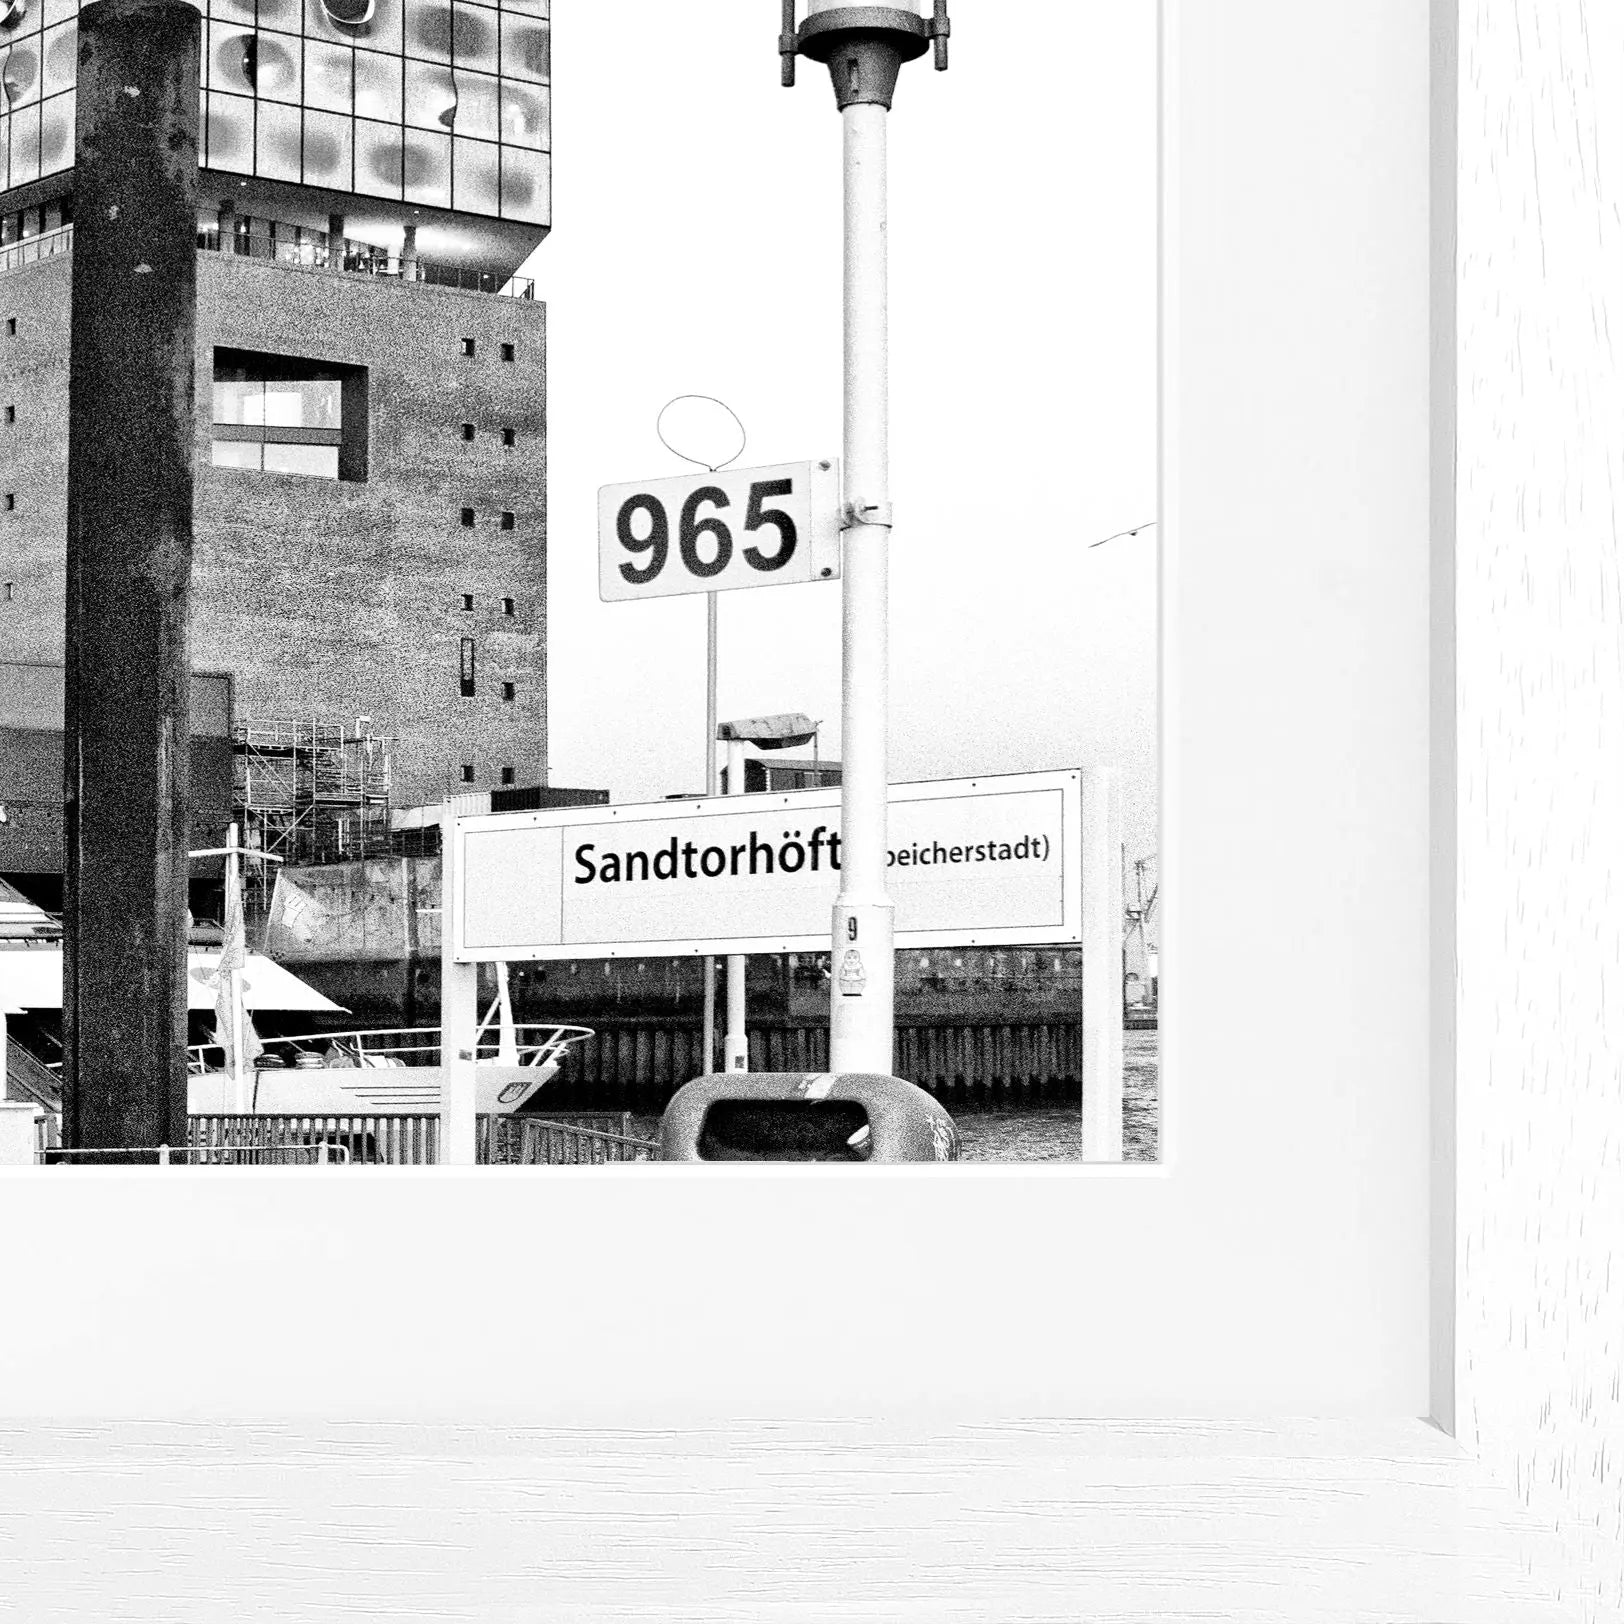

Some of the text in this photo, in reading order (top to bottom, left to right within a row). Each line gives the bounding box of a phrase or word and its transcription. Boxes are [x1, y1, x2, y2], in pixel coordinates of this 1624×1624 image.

[616, 478, 797, 584] 965
[575, 826, 841, 884] Sandtorhöft
[848, 916, 858, 941] 9
